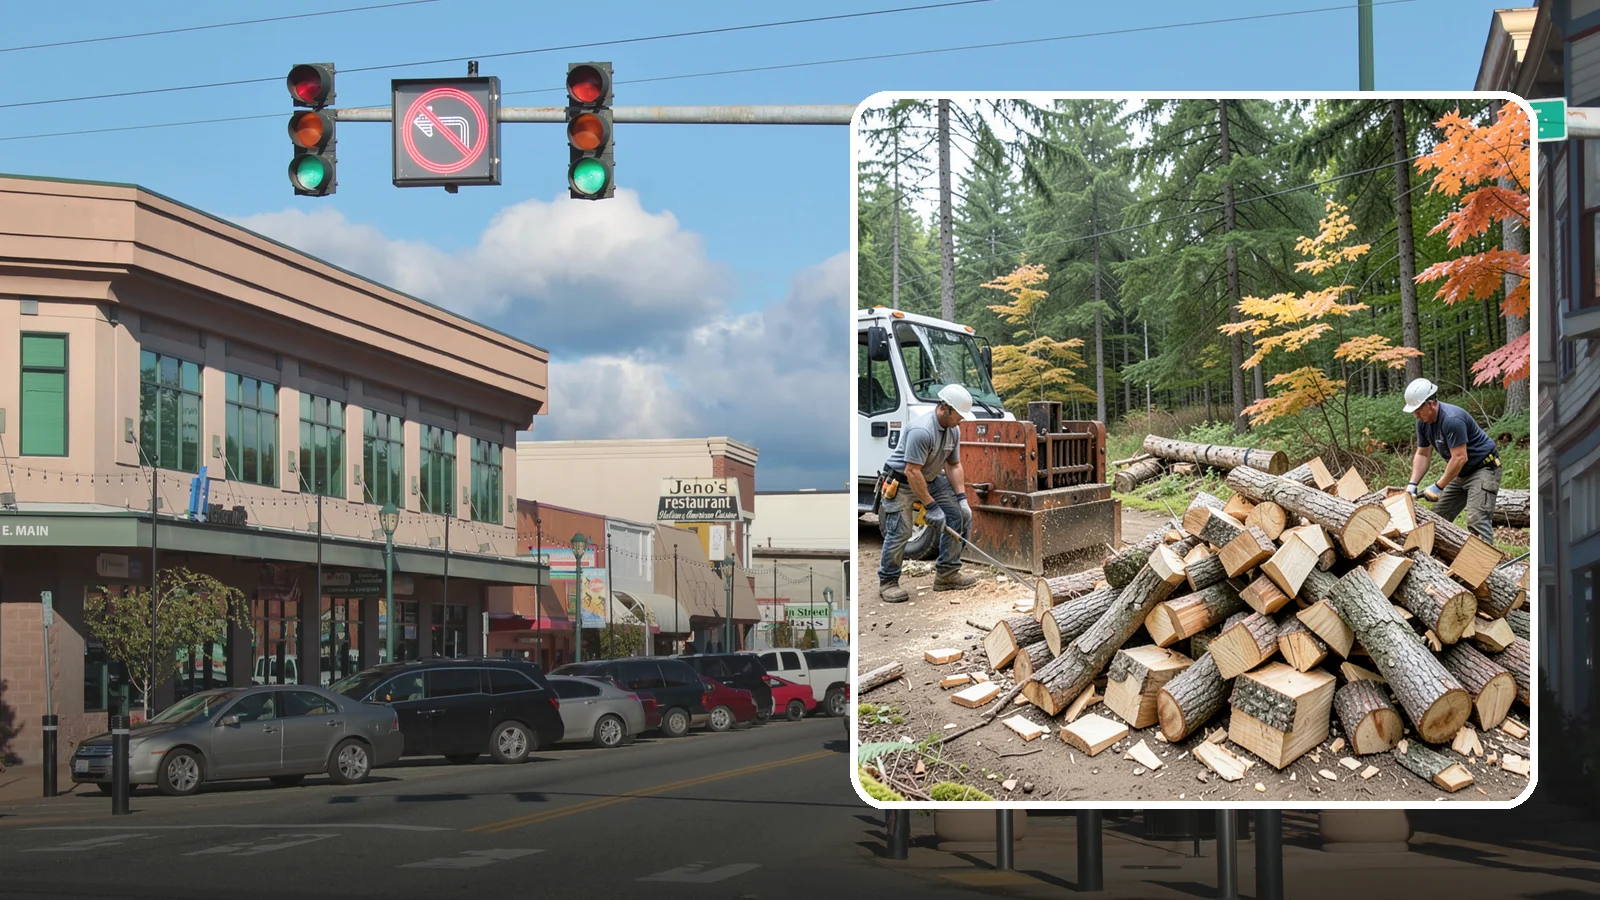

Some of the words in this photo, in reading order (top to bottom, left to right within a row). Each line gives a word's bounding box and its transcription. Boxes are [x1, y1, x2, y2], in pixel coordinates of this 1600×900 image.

[669, 480, 727, 494] Jeno's
[665, 496, 731, 509] restaurant
[658, 510, 681, 520] Italian
[686, 510, 715, 519] American
[715, 509, 738, 519] Cuisine
[2, 525, 13, 536] E.
[15, 525, 49, 536] MAIN
[797, 607, 828, 617] Street
[791, 619, 824, 627] lass
